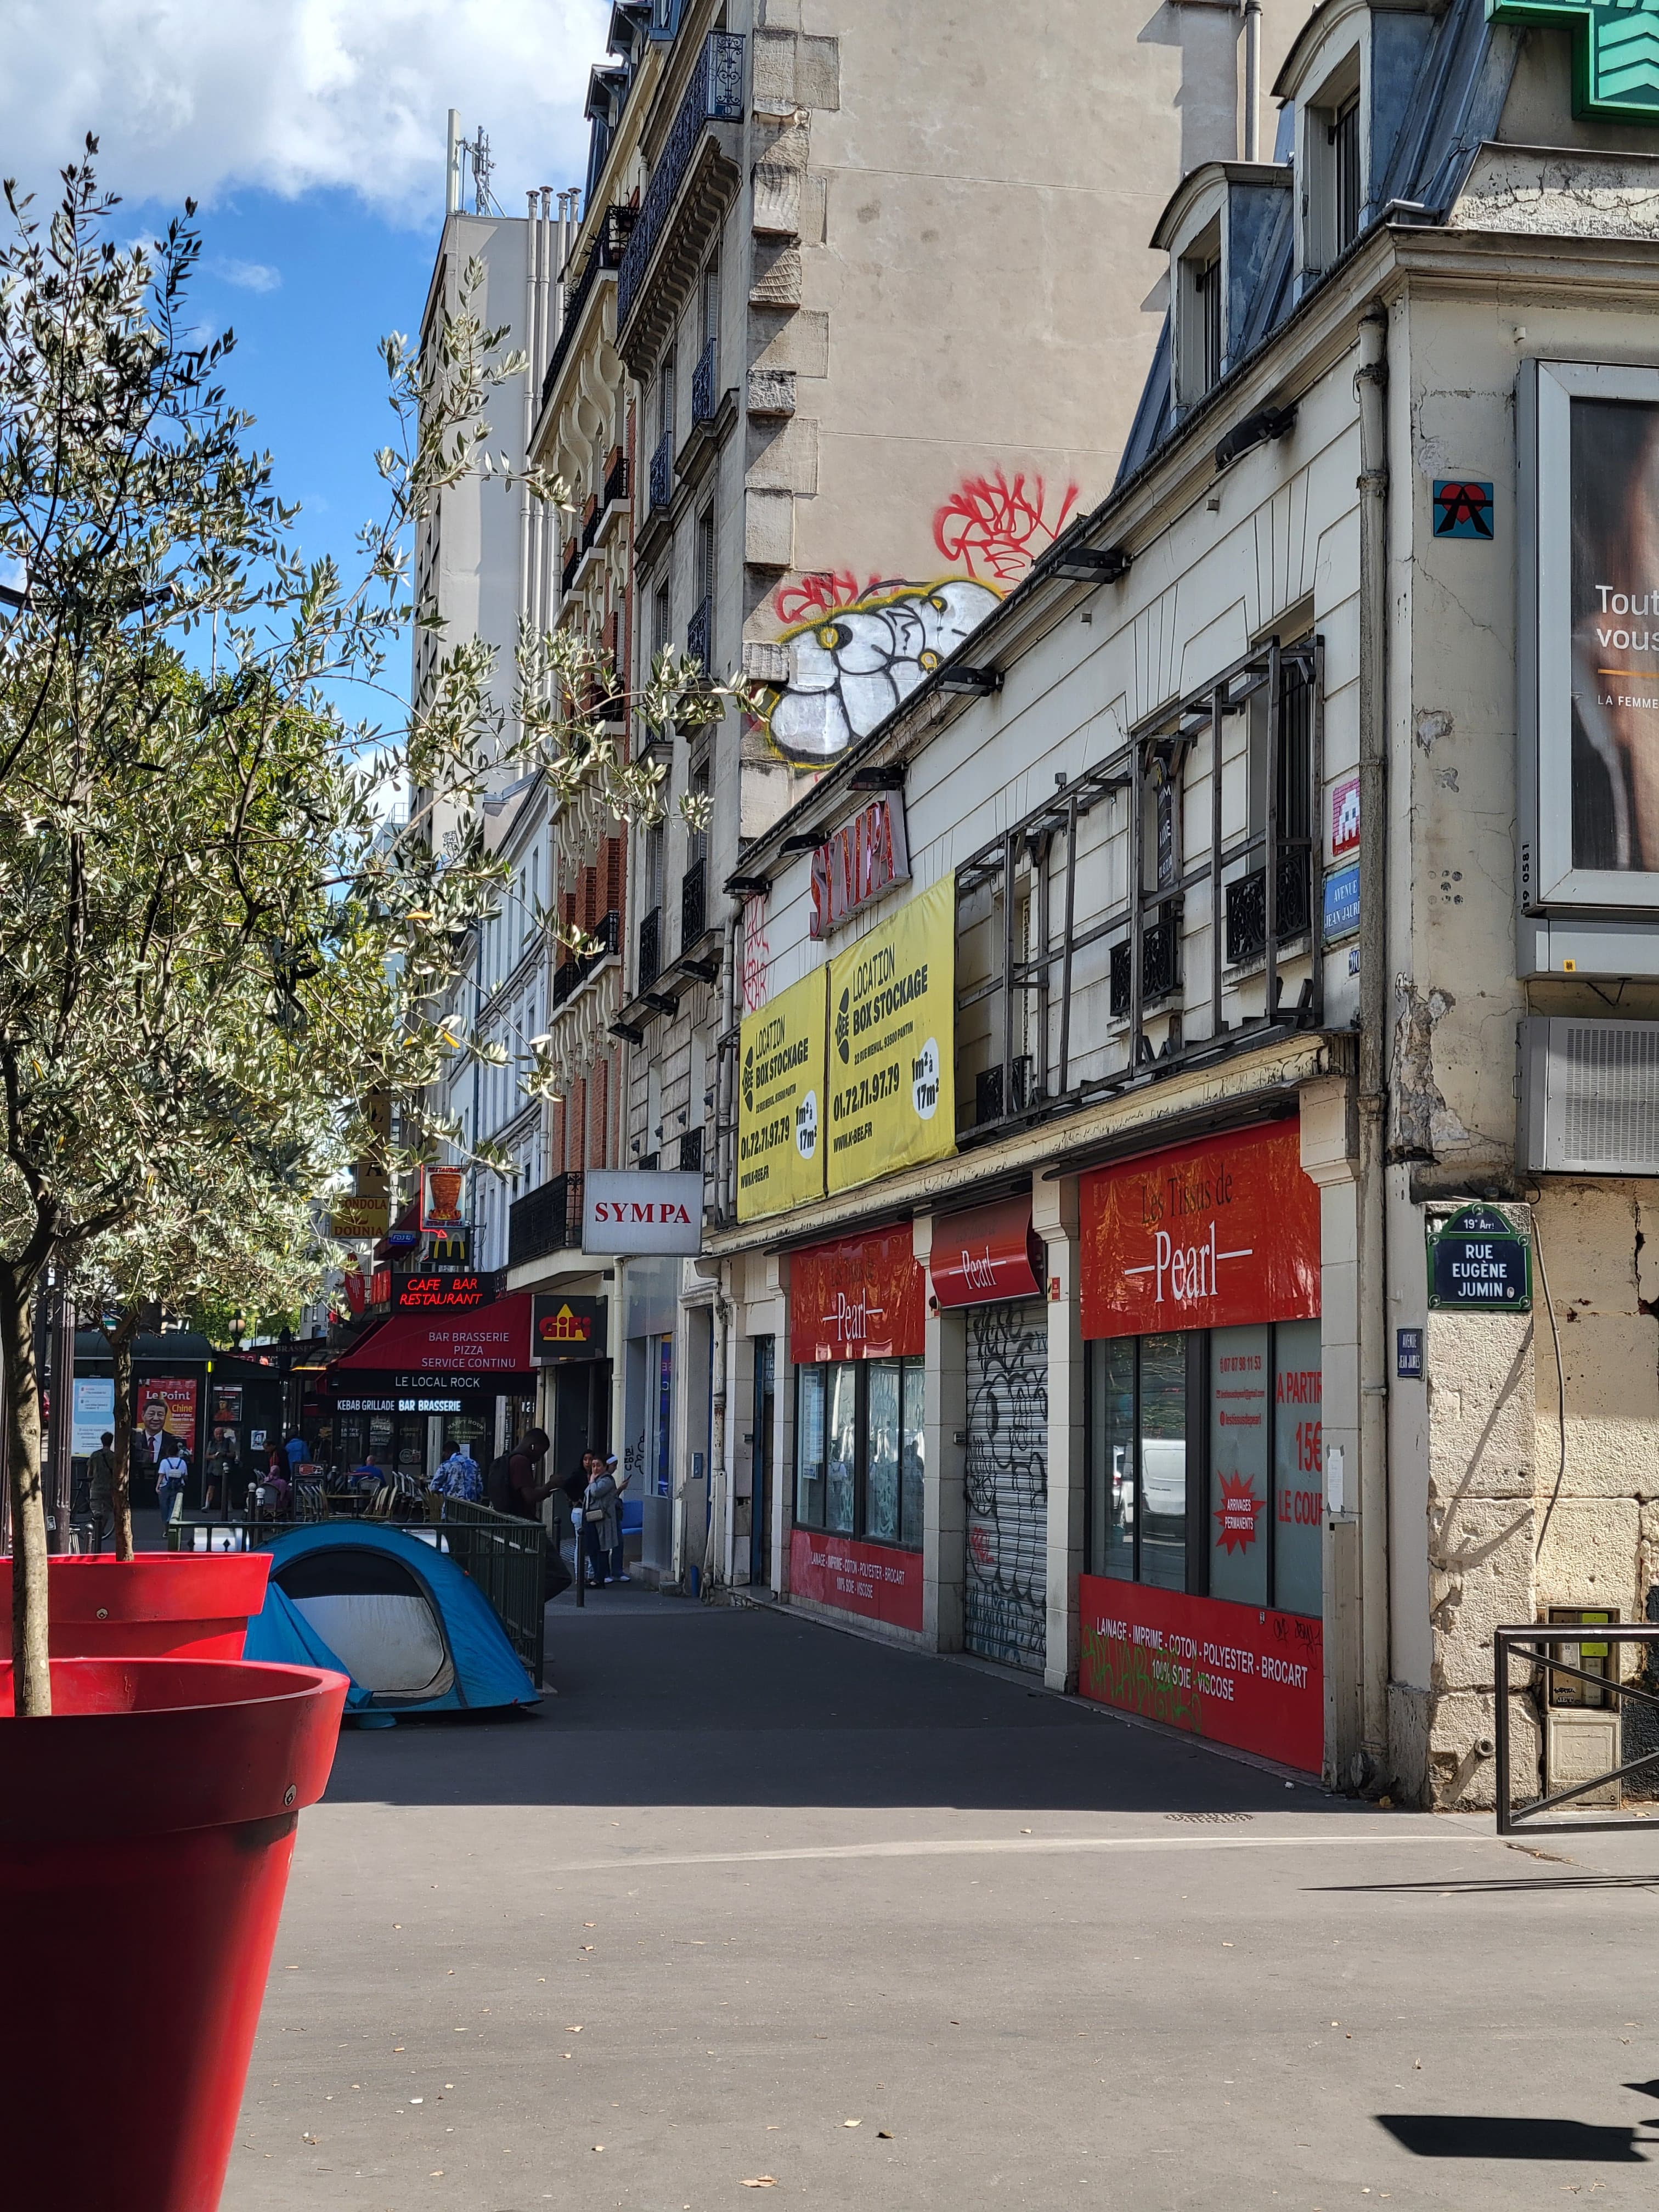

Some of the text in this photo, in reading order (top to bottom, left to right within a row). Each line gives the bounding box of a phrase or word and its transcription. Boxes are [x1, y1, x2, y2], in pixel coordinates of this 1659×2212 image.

[1598, 695, 1658, 709] LA FEMME
[810, 791, 898, 939] SYMPA
[1522, 844, 1530, 883] 0581
[1334, 879, 1357, 903] AVENUE
[1324, 909, 1341, 929] JEAN
[853, 942, 895, 1003] LOCATION
[853, 964, 928, 1037] BOX STOCKAGE
[755, 1014, 786, 1060] LOCATION
[854, 1053, 859, 1066] 22
[884, 1032, 898, 1052] 93500
[898, 1020, 913, 1045] PANTIN
[755, 1037, 809, 1090] BOX STOCKAGE
[833, 1062, 900, 1122] 01.72.71.97.79
[741, 1114, 790, 1162] 01.72.71.97.79
[1142, 1163, 1233, 1224] Les Tissus de
[595, 1202, 692, 1224] SYMPA
[334, 1226, 383, 1235] DOUNIA
[1154, 1220, 1219, 1303] Pearl
[1465, 1244, 1493, 1259] RUE
[961, 1244, 997, 1290] Pearl
[1452, 1260, 1508, 1278] EUGÈNE
[407, 1278, 477, 1291] CAFE BAR
[1458, 1282, 1503, 1297] JUMIN
[399, 1293, 483, 1306] RESTAURANT
[837, 1286, 867, 1342] Pearl
[428, 1332, 509, 1342] BAR BRASSERIE
[1402, 1334, 1417, 1348] AVENUE
[454, 1346, 483, 1355] PIZZA
[421, 1358, 516, 1368] SERVICE CONTINU
[1247, 1356, 1252, 1371] 11
[1398, 1355, 1408, 1369] JEAN
[395, 1376, 481, 1387] LE LOCAL ROCK
[1277, 1372, 1284, 1404] A
[146, 1390, 190, 1400] Le Point
[172, 1404, 193, 1413] Chine
[337, 1400, 461, 1412] KEBAB GRILLADE BAR BRASSERIE
[467, 1419, 484, 1430] HOUR
[1227, 1498, 1251, 1512] ARRIVAGES
[1278, 1489, 1292, 1523] LE
[1224, 1516, 1254, 1531] PERMANENTS
[811, 1551, 905, 1585] LAINAGE IMPRIME COTON POLYESTER BROCART
[845, 1578, 854, 1594] SOIE
[857, 1581, 873, 1599] VISCOSE
[1097, 1616, 1308, 1689] LAINAGE IMPRIME COTON POLYESTER BROCART
[1152, 1658, 1234, 1701] 100% SOIE VISCOSE
